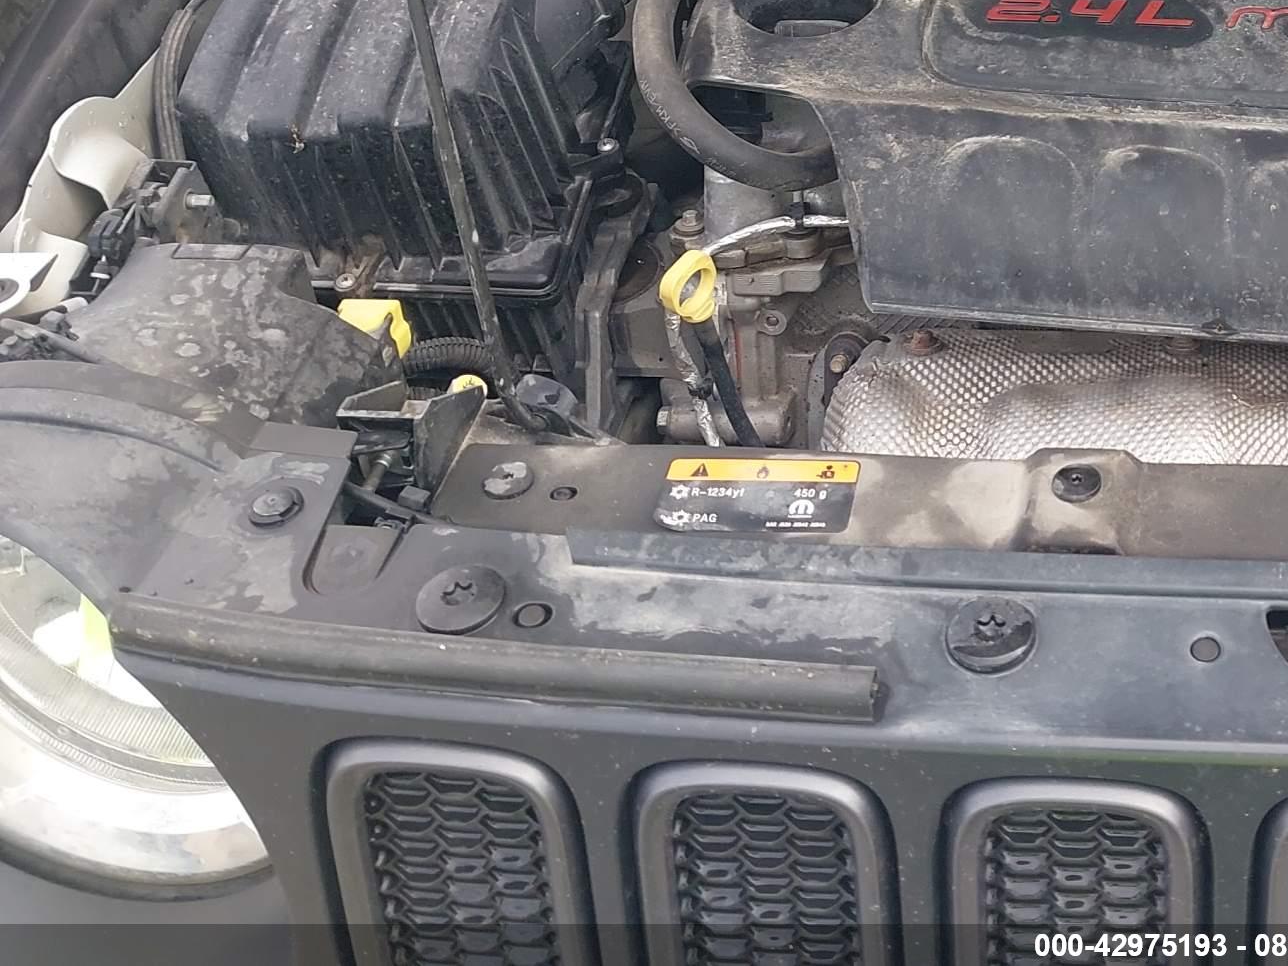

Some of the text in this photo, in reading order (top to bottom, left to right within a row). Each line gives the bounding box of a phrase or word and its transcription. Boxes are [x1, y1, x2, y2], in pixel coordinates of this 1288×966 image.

[793, 489, 815, 498] 450
[819, 490, 828, 500] g
[693, 513, 717, 523] PAG
